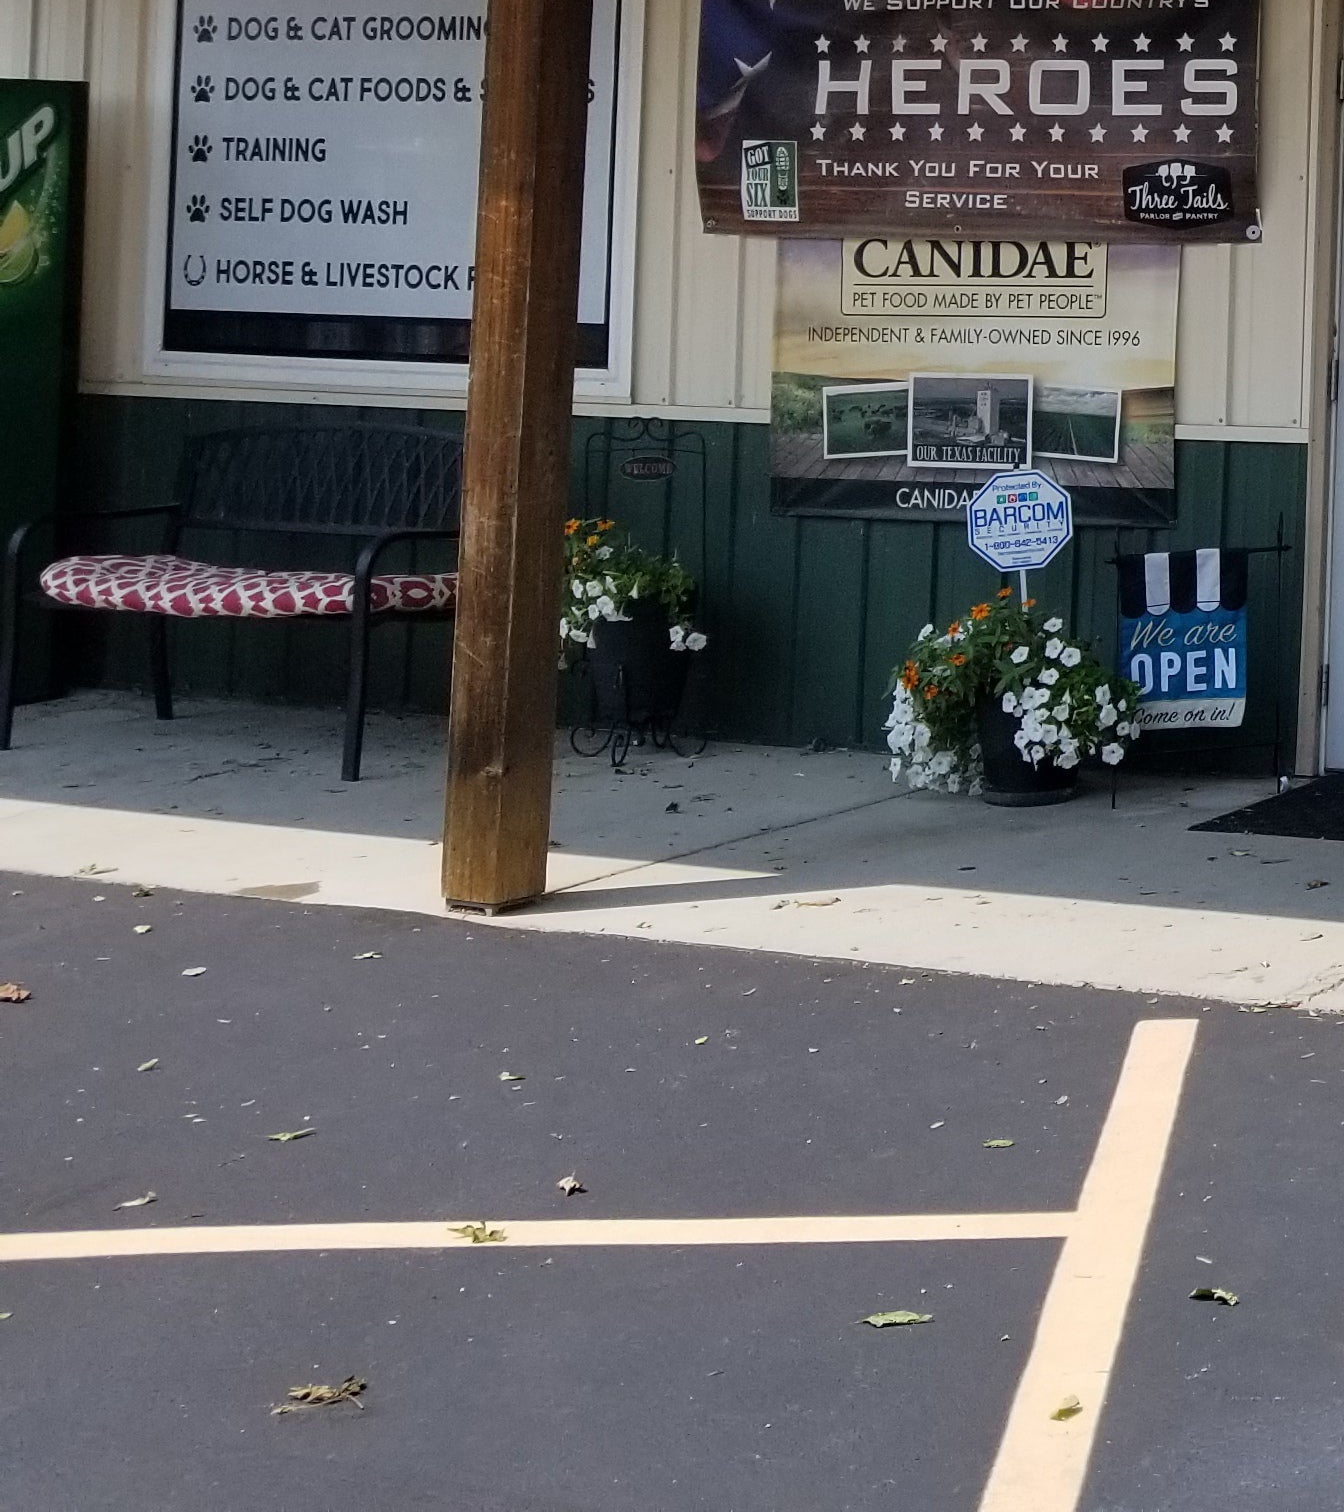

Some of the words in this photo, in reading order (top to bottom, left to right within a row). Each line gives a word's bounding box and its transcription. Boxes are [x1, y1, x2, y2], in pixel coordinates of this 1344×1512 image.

[227, 16, 279, 41] DOG
[286, 15, 304, 41] &
[310, 15, 356, 42] CAT
[362, 15, 489, 42] GROOMIN
[224, 76, 276, 102] DOG
[283, 76, 302, 102] &
[308, 76, 353, 103] CAT
[359, 77, 446, 103] FOODS
[453, 77, 472, 103] &
[814, 58, 1239, 117] HEROES
[222, 137, 327, 163] TRAINING
[747, 145, 770, 167] GOT
[746, 168, 769, 182] YOUR
[815, 159, 900, 179] THANK
[908, 159, 957, 179] YOU
[967, 160, 1022, 180] FOR
[1030, 160, 1101, 181] YOUR
[746, 182, 769, 208] SIX
[904, 190, 1009, 211] SERVICE
[1127, 181, 1178, 210] Three
[1180, 183, 1229, 210] Tails
[218, 197, 274, 223] SELF
[280, 198, 333, 224] DOG
[340, 199, 409, 226] WASH
[746, 209, 777, 219] SUPPORT
[778, 209, 798, 220] DOGS
[1139, 212, 1170, 221] PARLOR
[1185, 212, 1219, 221] PANTRY
[853, 238, 1095, 280] CANIDAE
[216, 259, 295, 286] HORSE
[301, 260, 319, 286] &
[326, 262, 460, 291] LIVESTOCK
[852, 292, 878, 309] PET
[882, 292, 928, 310] FOOD
[933, 293, 979, 310] MADE
[984, 293, 1004, 310] BY
[1007, 294, 1034, 310] PET
[807, 326, 910, 345] INDEPENDENT
[914, 327, 926, 344] &
[930, 328, 1052, 346] FAMILY-OWNED
[1056, 330, 1103, 347] SINCE
[1107, 331, 1141, 348] 1996
[916, 445, 938, 461] OUR
[942, 446, 973, 462] TEXAS
[976, 447, 1021, 463] FACILITY
[974, 501, 1065, 528] BARCOM
[1129, 618, 1175, 651] We
[1183, 621, 1237, 647] are
[1130, 647, 1237, 696] OPEN
[1131, 705, 1179, 727] Come
[1184, 706, 1206, 723] on
[1210, 701, 1236, 723] in!
